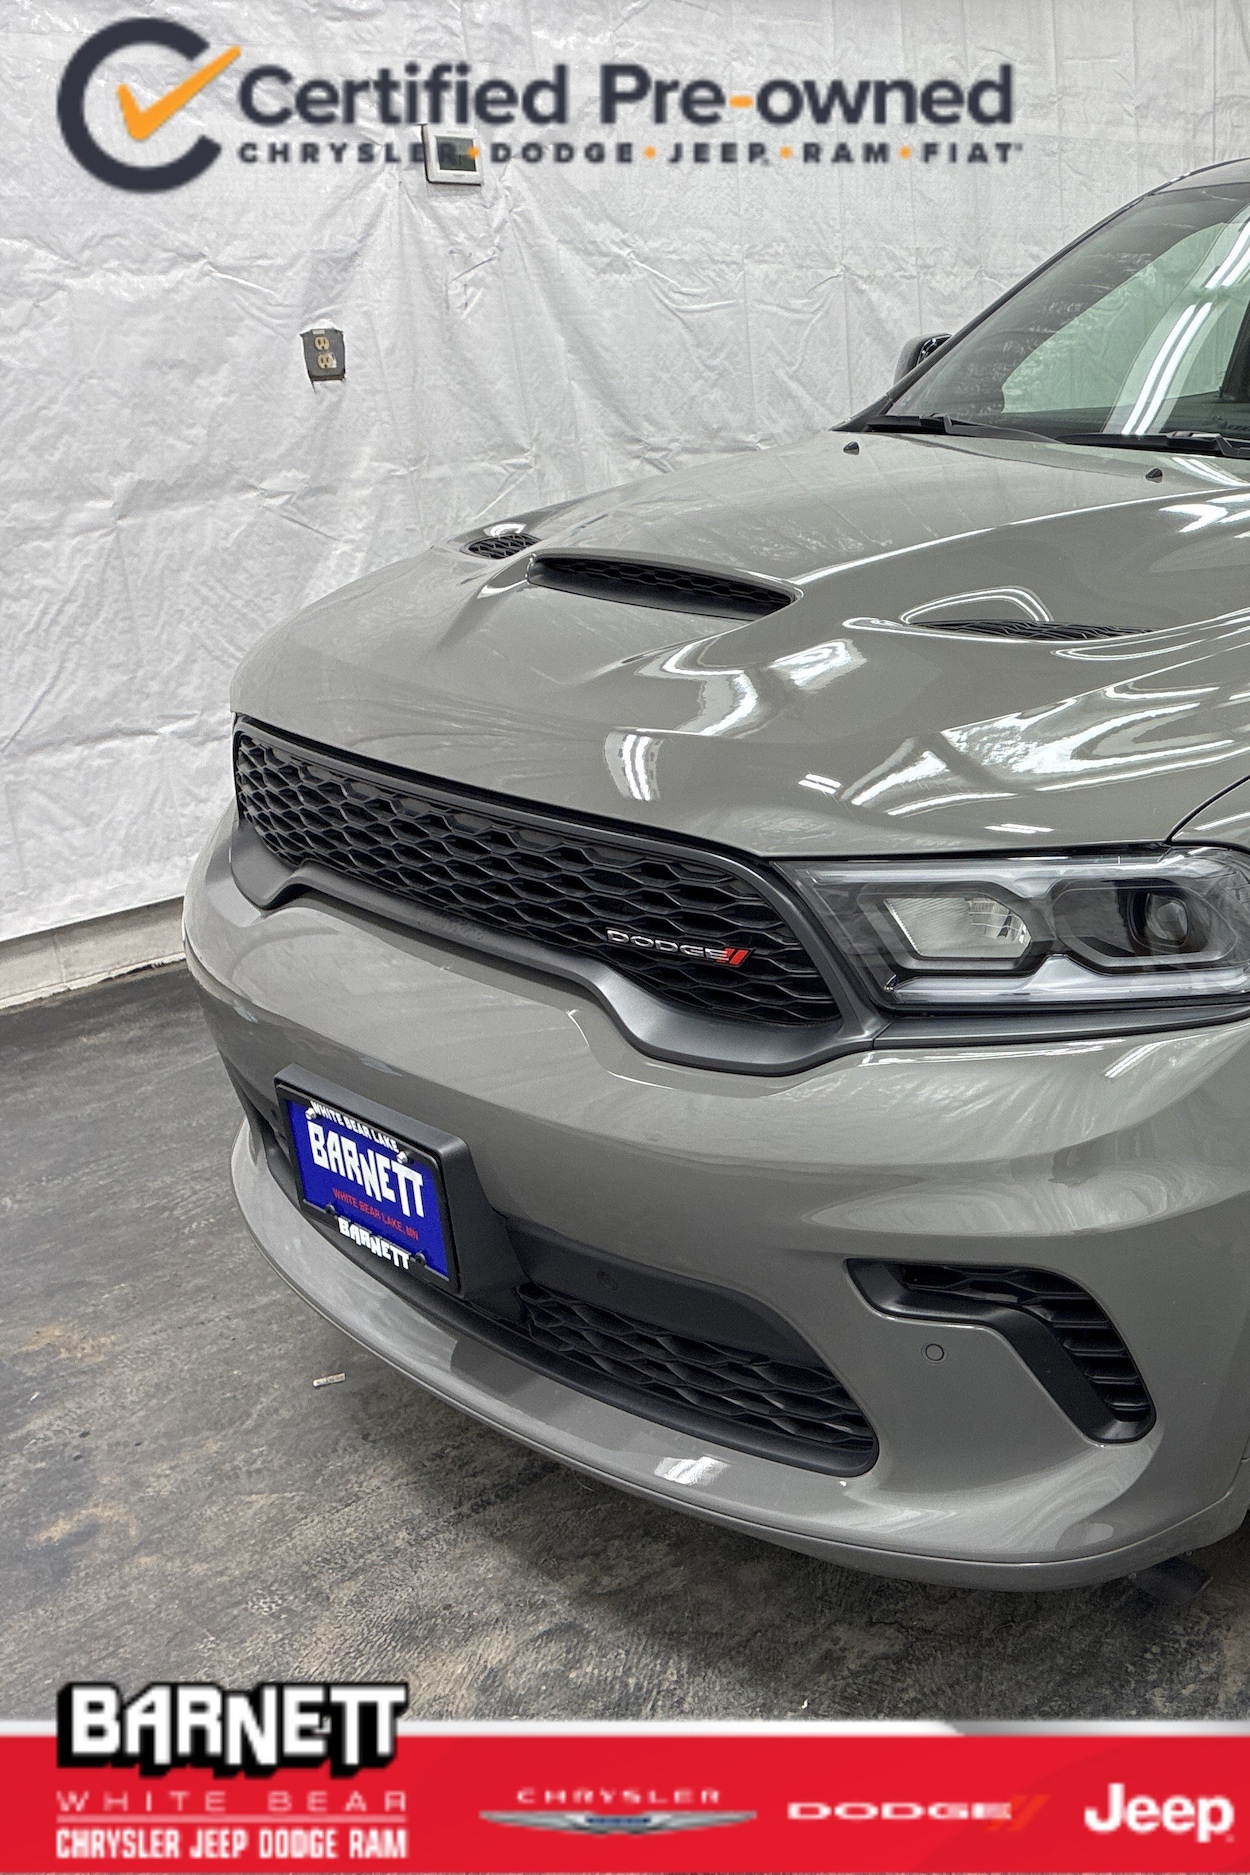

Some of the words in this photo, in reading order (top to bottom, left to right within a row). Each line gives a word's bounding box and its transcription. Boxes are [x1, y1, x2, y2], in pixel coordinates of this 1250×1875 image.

[606, 929, 730, 961] DODGE
[310, 1100, 345, 1127] WHITE
[343, 1116, 372, 1140] BEAR
[371, 1129, 399, 1153] LAKE
[307, 1120, 424, 1218] BARNETT
[332, 1187, 360, 1209] WHITE
[359, 1201, 381, 1220] BEAR
[338, 1216, 410, 1270] BARNETT
